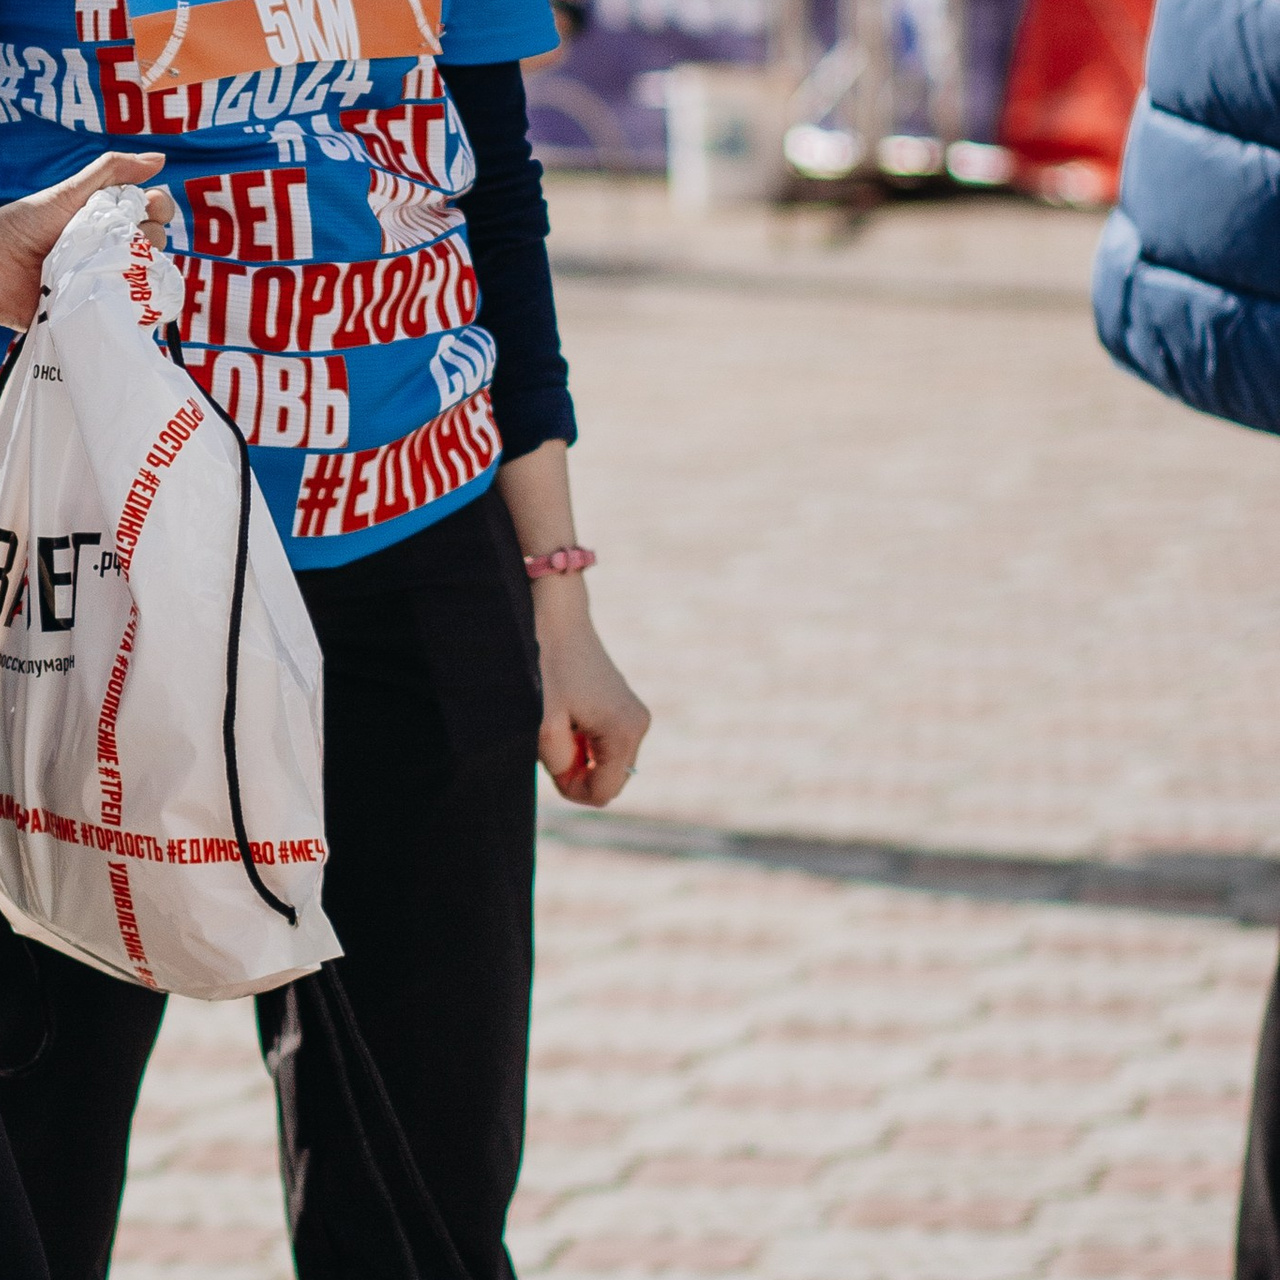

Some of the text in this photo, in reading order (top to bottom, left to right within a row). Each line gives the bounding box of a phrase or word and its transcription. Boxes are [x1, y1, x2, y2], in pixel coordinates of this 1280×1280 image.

[119, 602, 140, 653] ЕЧТА
[97, 653, 130, 766] #ВОЛНЕНИЕ
[80, 821, 163, 863] #ГОРДОСТЬ
[166, 838, 276, 866] #ЕДИНСВО
[108, 860, 149, 965] УДИВЛЕНИЕ
